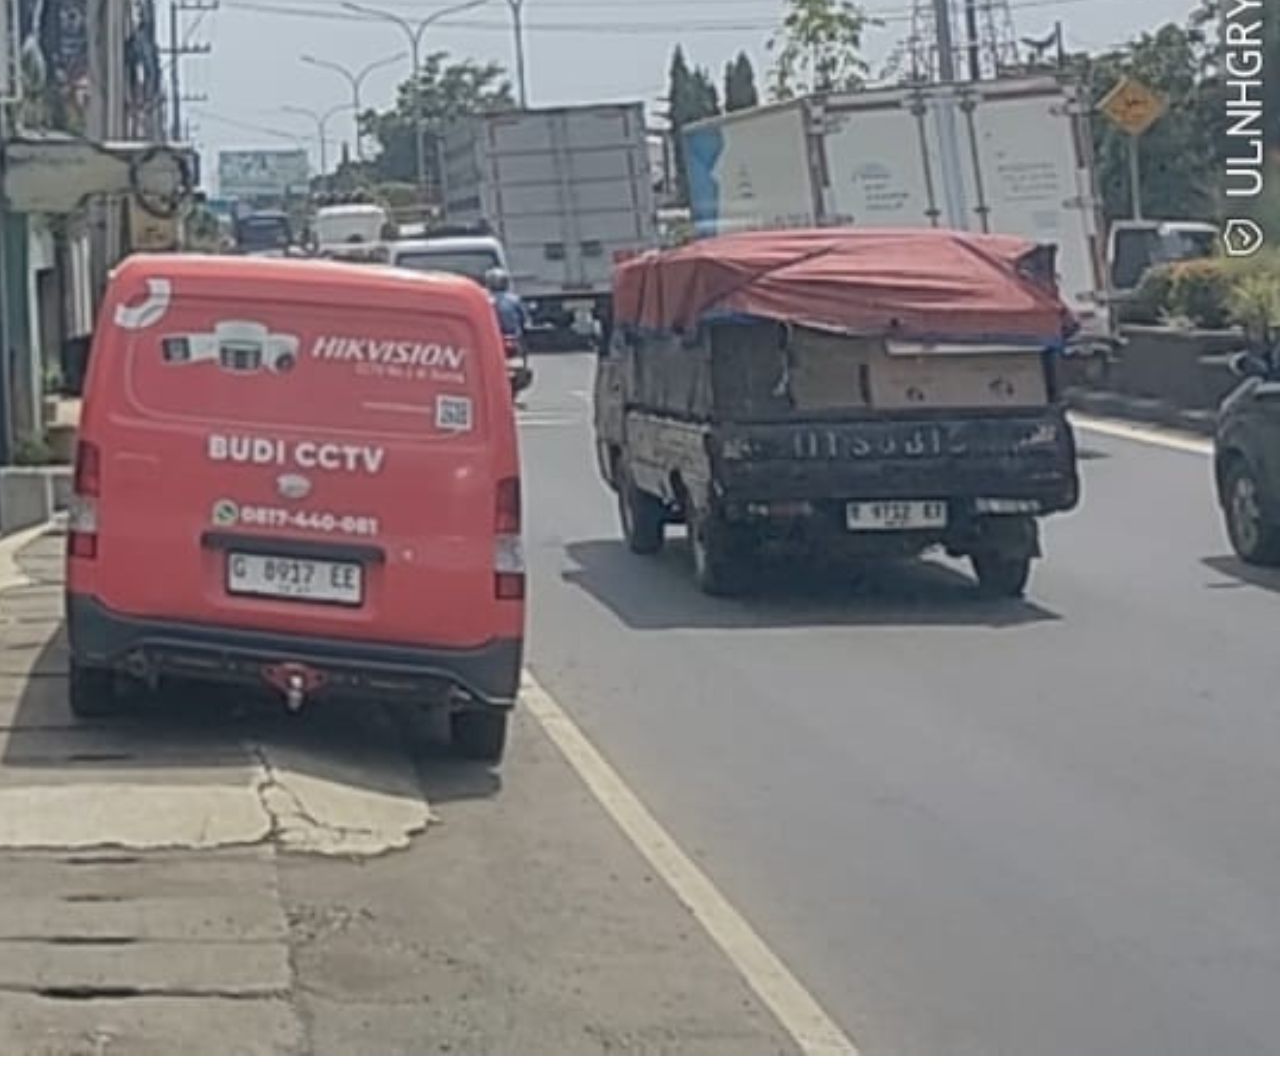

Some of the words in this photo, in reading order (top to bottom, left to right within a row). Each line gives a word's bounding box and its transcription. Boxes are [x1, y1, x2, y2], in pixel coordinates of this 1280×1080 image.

[312, 335, 465, 368] HIKVISION
[208, 434, 285, 465] BUDI
[294, 441, 385, 473] CCTV
[233, 557, 247, 578] G
